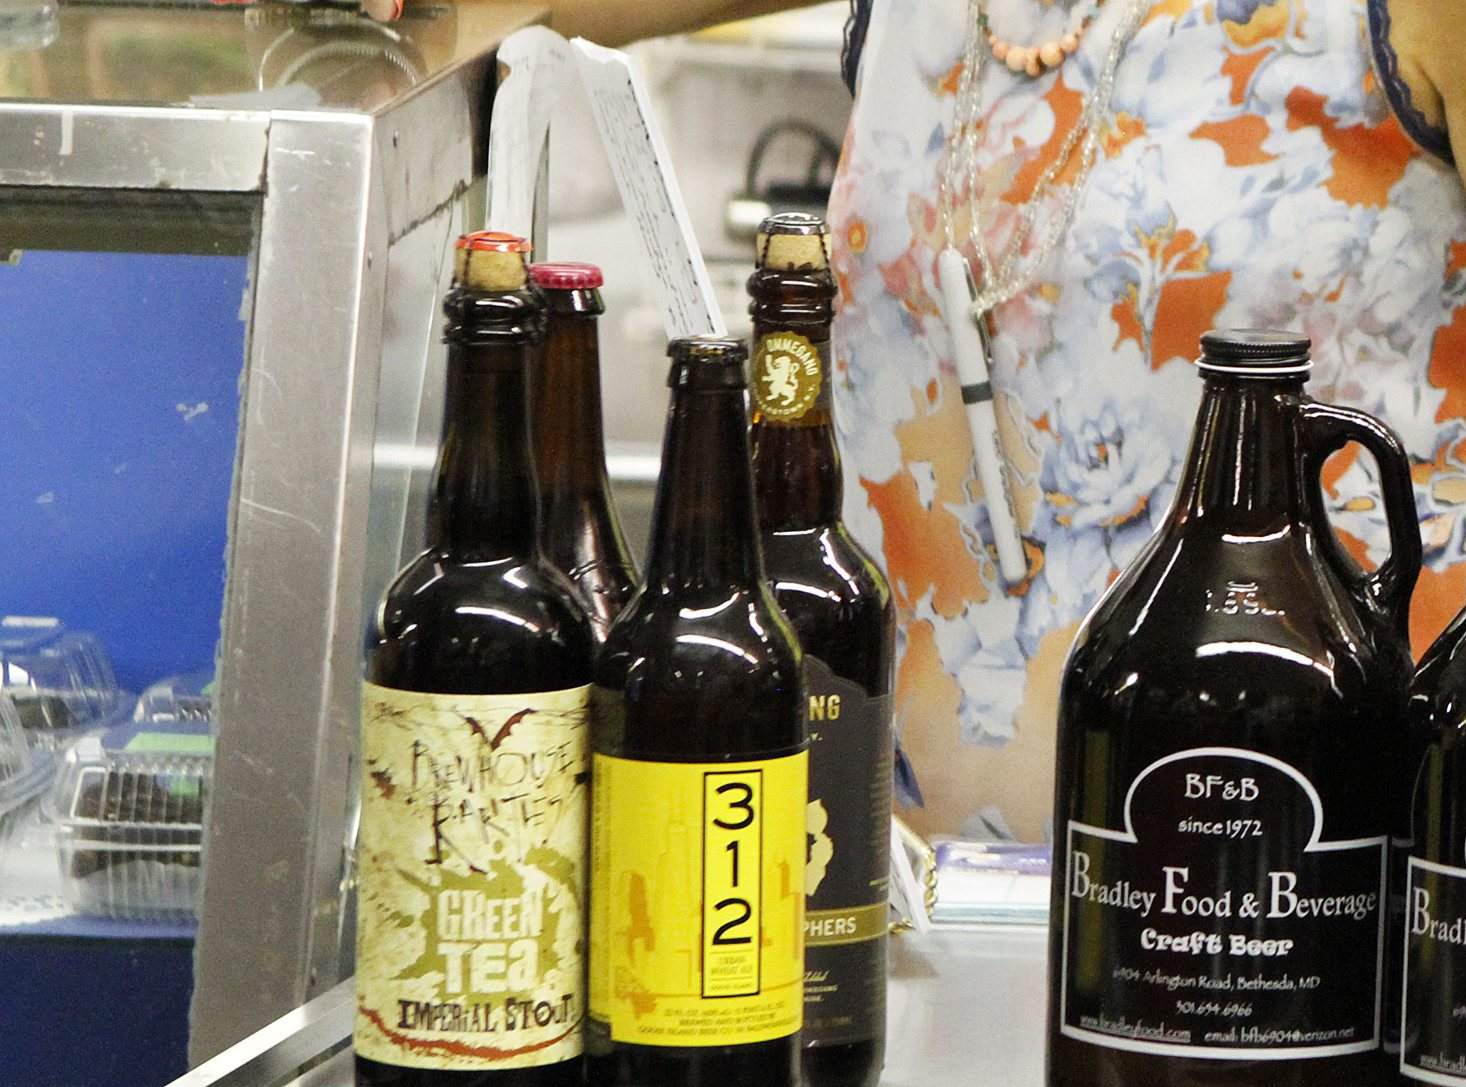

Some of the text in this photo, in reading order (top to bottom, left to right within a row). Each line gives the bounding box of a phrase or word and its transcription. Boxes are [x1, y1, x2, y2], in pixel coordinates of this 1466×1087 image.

[1184, 773, 1260, 802] BF&B
[1177, 815, 1264, 839] since 1972
[1071, 851, 1377, 921] Bradley Food & Beverage
[436, 888, 545, 941] GREEN
[1140, 928, 1294, 957] Craft Beer
[1299, 975, 1321, 989] MD
